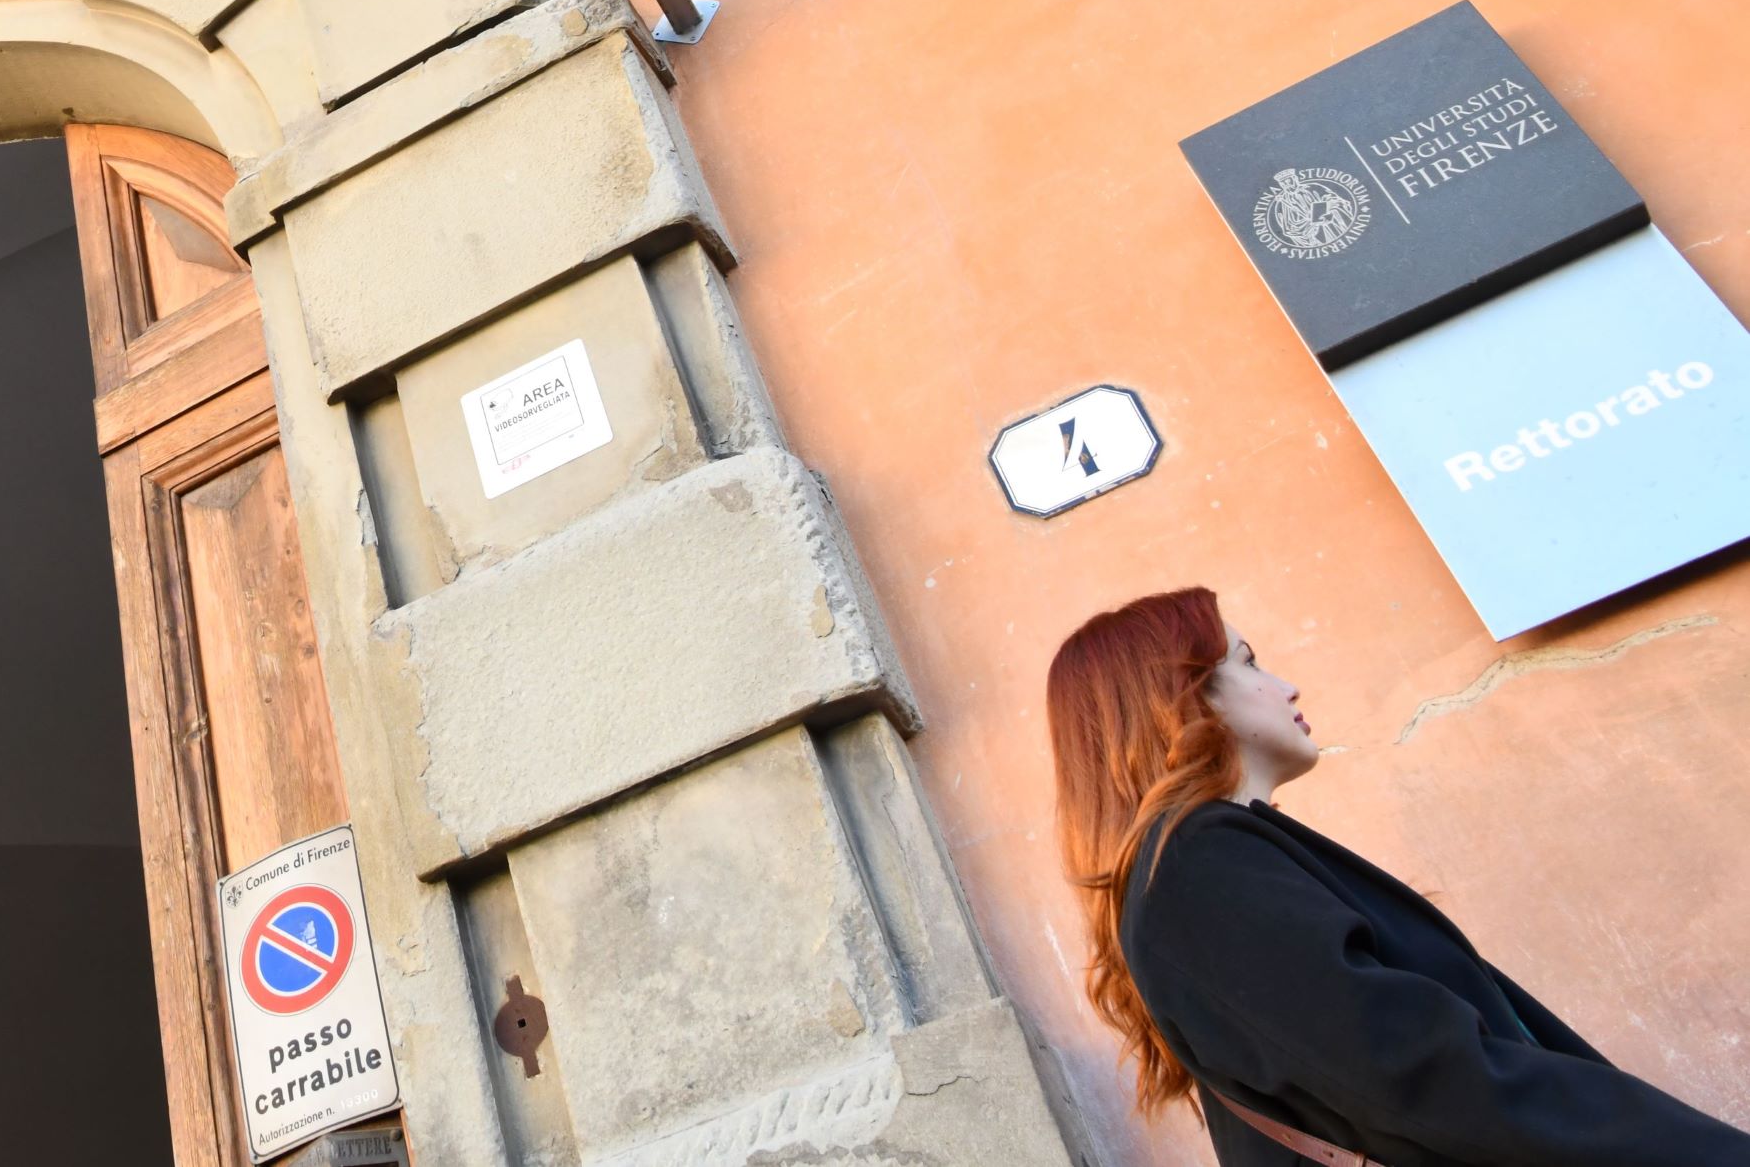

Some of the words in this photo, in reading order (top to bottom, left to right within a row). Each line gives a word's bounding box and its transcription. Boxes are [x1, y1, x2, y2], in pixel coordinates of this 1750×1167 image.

[1370, 78, 1525, 157] UNIVERSITÀ
[1384, 131, 1459, 174] DEGLI
[1462, 94, 1538, 137] STUDI
[1397, 110, 1558, 198] FIRENZE
[1298, 167, 1371, 209] STUDIORUM
[1253, 186, 1282, 252] FLORENTINA
[1288, 214, 1371, 259] UNIVERSITAS
[494, 391, 570, 432] VIDEOSORVEGLIATA
[523, 378, 565, 406] AREA
[1058, 416, 1101, 478] 4
[1443, 361, 1714, 492] Rettorato
[245, 863, 290, 891] Comune
[293, 852, 305, 869] di
[307, 839, 351, 863] Firenze
[269, 1018, 352, 1074] passo
[255, 1047, 382, 1115] carrabile
[259, 1112, 324, 1146] Autorizzazione
[326, 1107, 335, 1117] n.
